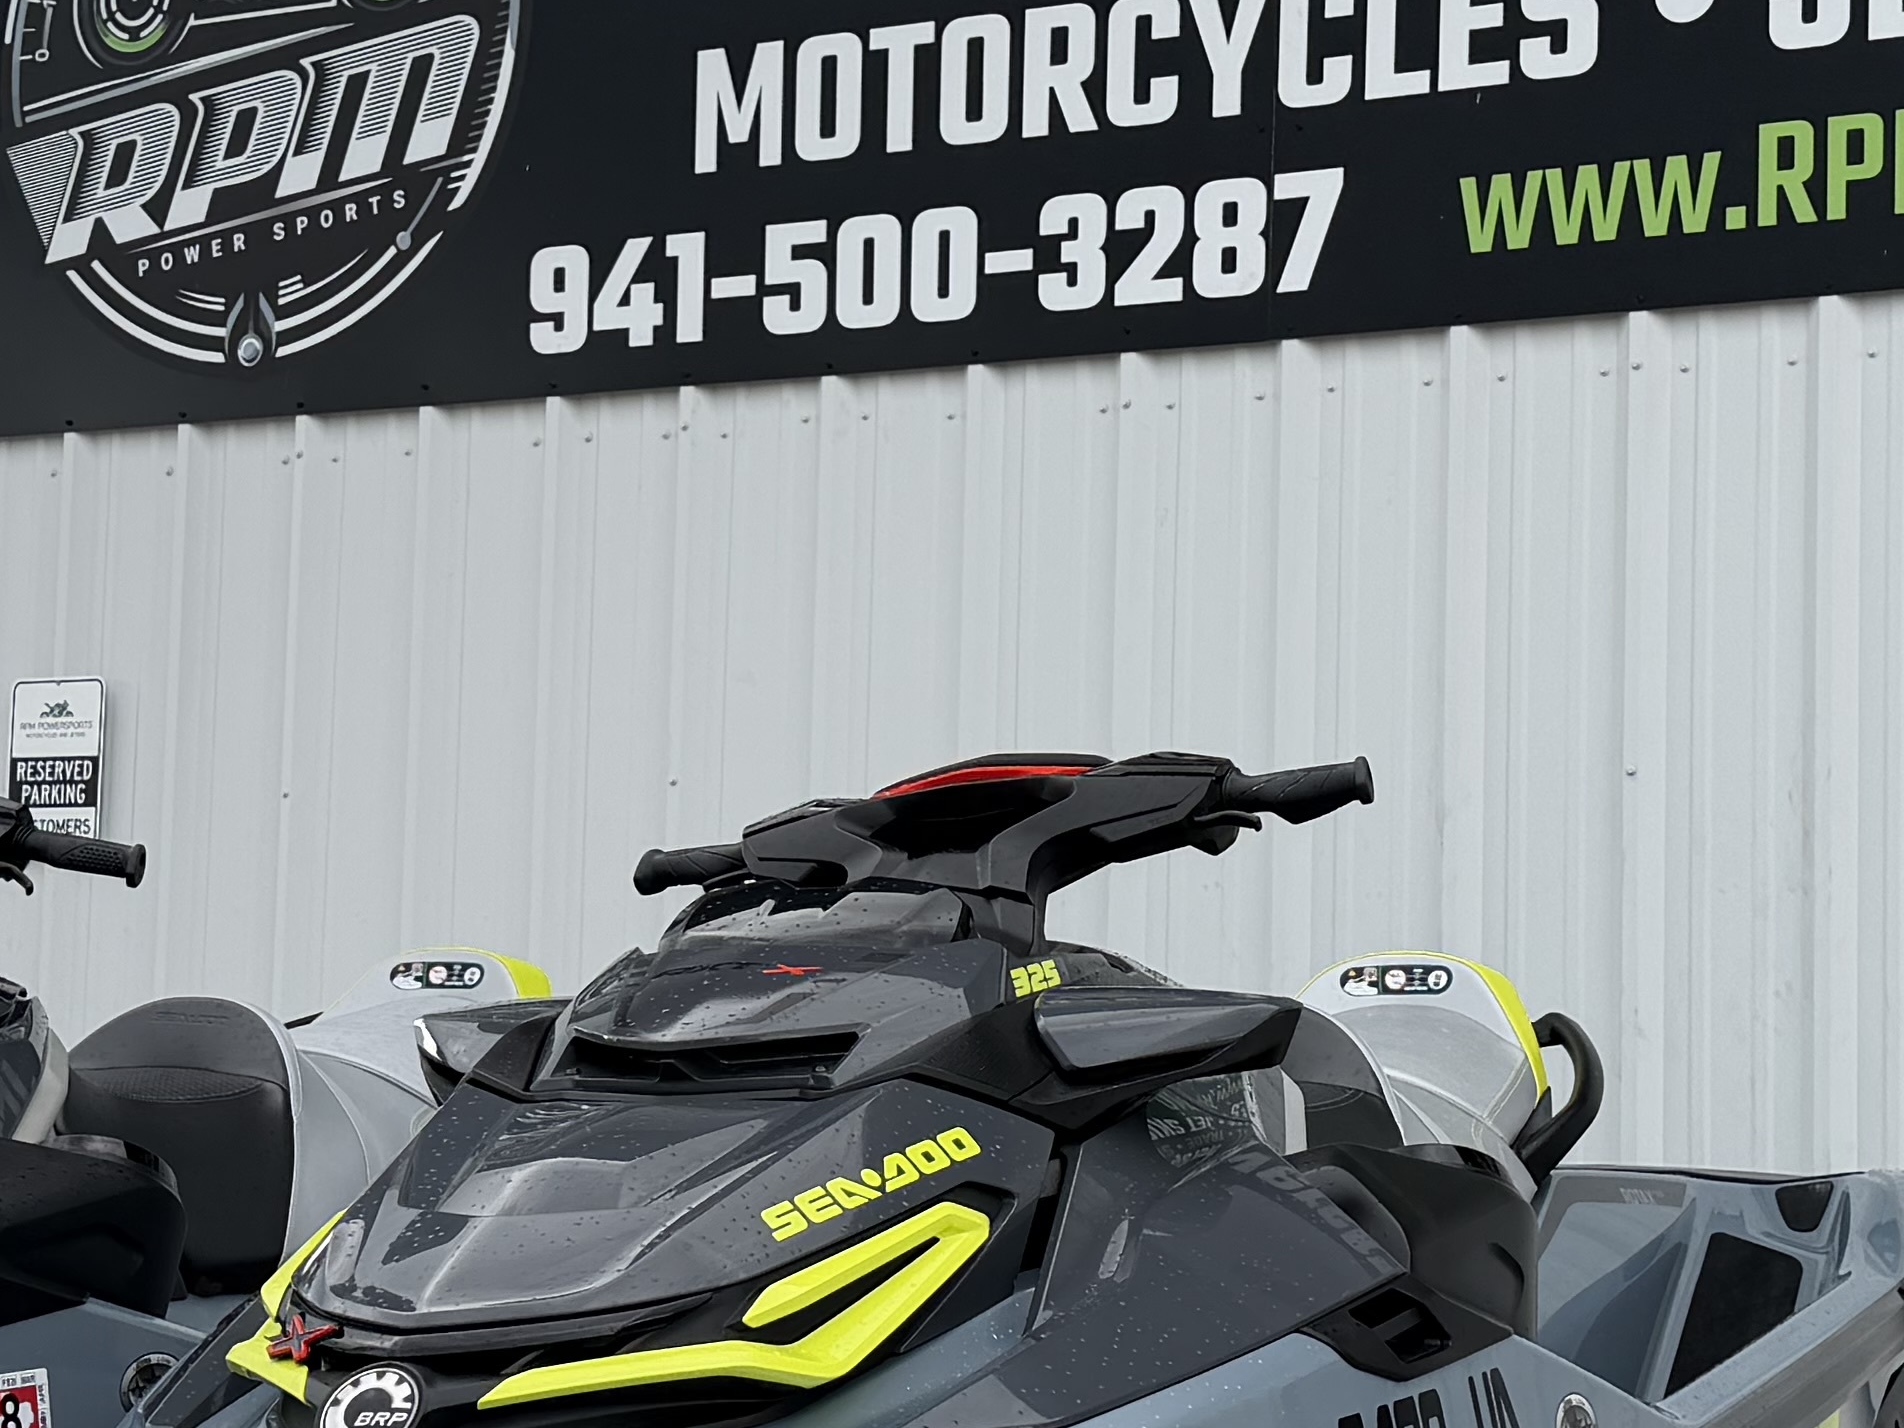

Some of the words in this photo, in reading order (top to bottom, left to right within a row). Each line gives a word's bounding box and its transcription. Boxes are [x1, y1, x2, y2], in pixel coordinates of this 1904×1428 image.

[137, 233, 246, 277] POWER
[273, 189, 408, 241] SPORTS
[530, 167, 1344, 354] 941-500-3287
[16, 759, 93, 782] RESERVED
[21, 783, 86, 805] PARKING
[1009, 959, 1061, 998] 325
[354, 1411, 408, 1427] BRP
